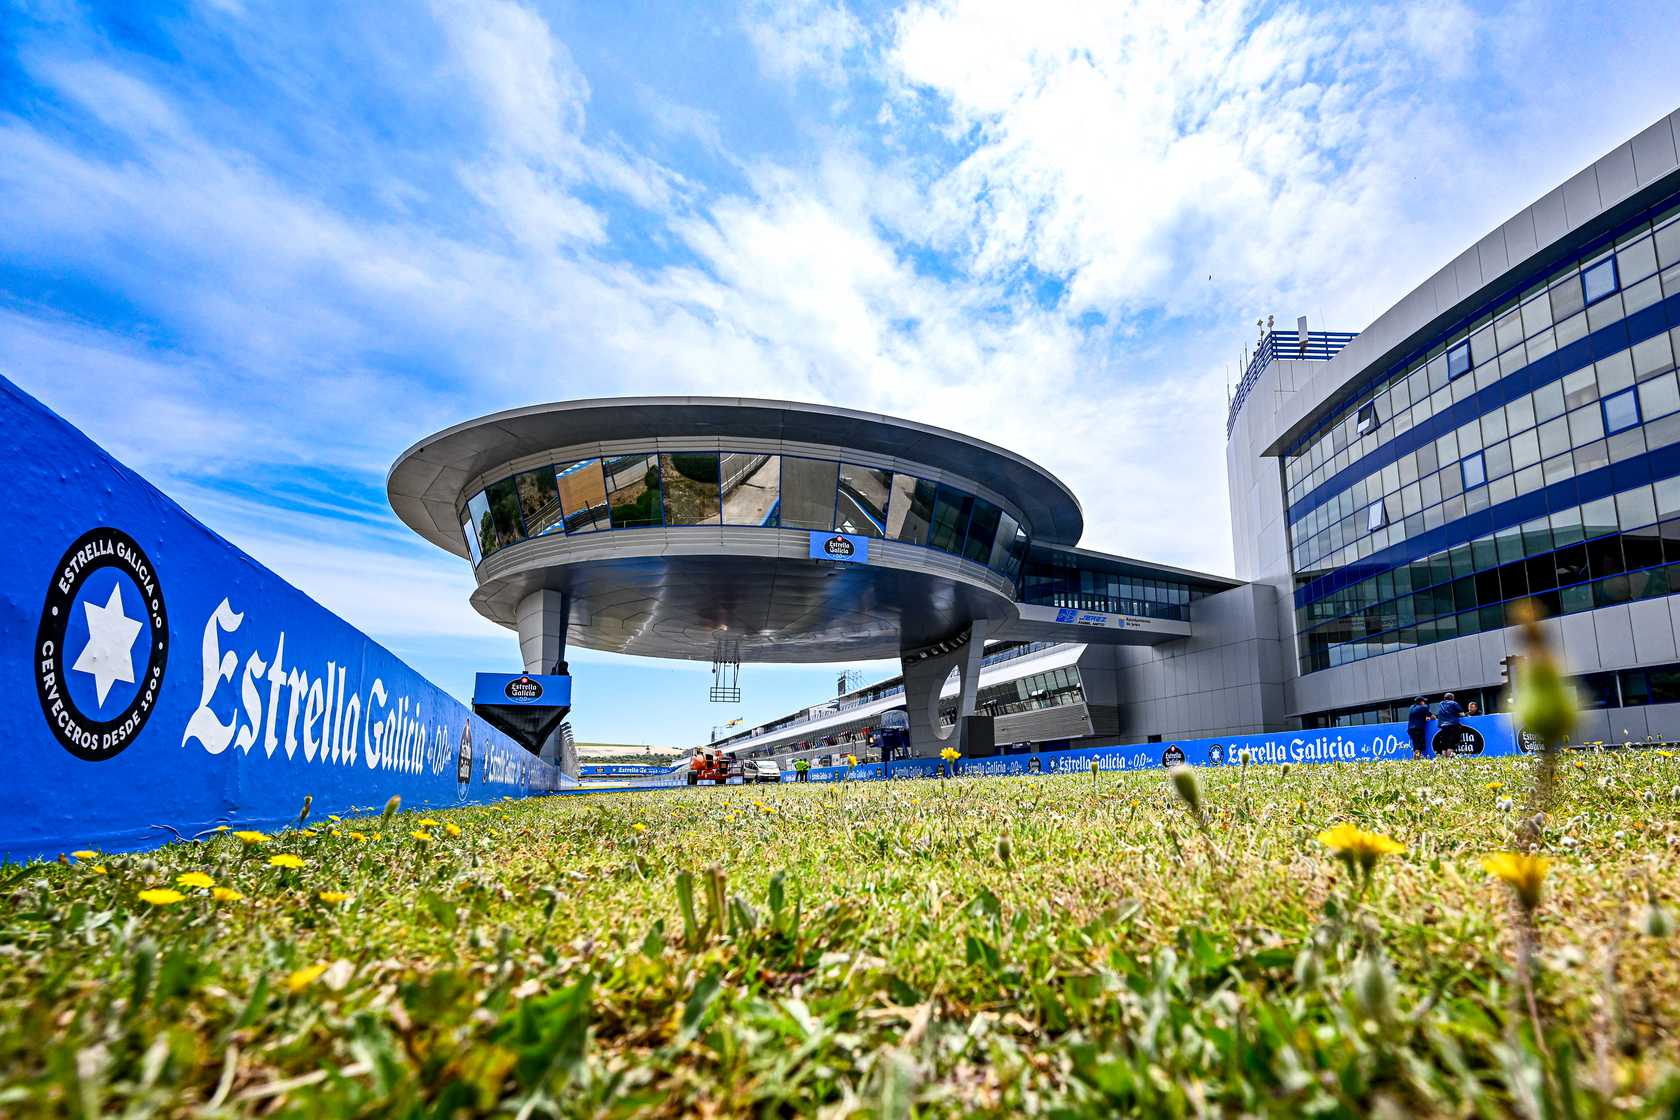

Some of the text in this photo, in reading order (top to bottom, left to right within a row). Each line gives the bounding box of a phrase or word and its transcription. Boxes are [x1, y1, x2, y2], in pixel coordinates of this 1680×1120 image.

[829, 540, 850, 548] Estrella
[829, 546, 849, 554] Galicia
[58, 539, 115, 595] ESTRELLA
[116, 542, 155, 597] GALICIA
[41, 640, 161, 750] CERVECEROS DESDE 1906
[181, 596, 361, 767] Estrella
[365, 677, 425, 775] Galicia
[1290, 736, 1357, 761] Galicia
[1372, 734, 1397, 757] 0,0
[1059, 755, 1091, 771] Estrella
